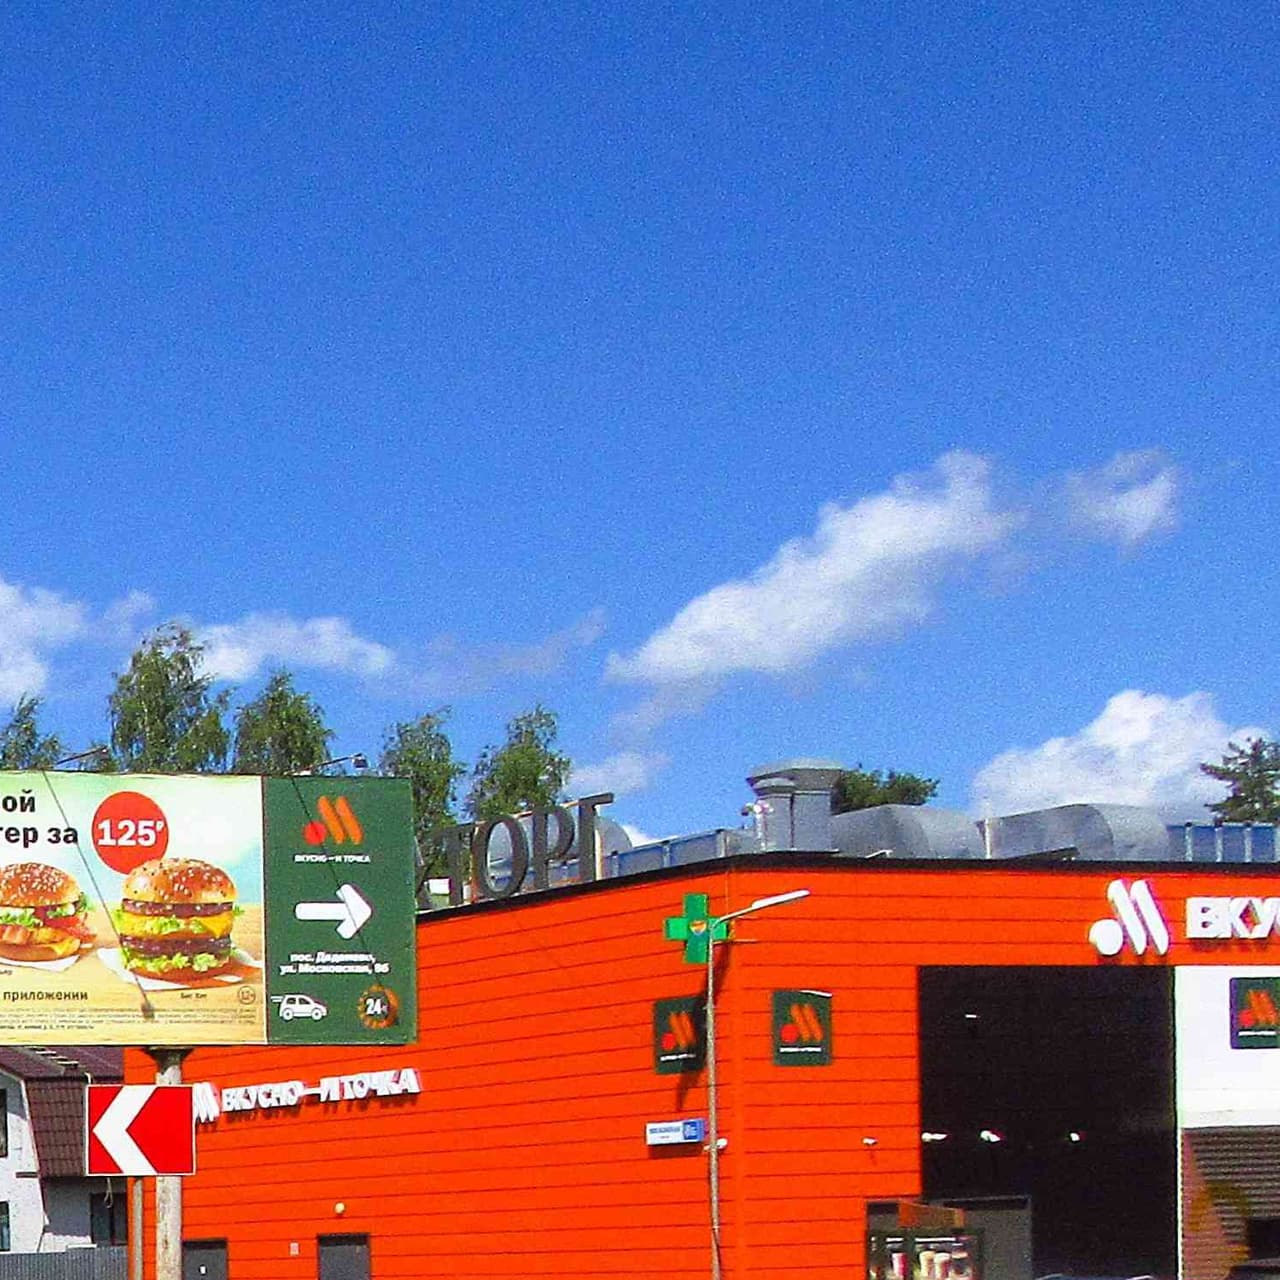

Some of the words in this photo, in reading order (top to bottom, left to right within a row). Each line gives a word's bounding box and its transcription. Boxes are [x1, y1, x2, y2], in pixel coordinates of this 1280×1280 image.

[47, 828, 78, 844] за
[1186, 897, 1280, 938] ВКУ
[3, 990, 89, 1002] приложении
[222, 1080, 306, 1112] ВКУСНО
[341, 1068, 421, 1099] ТОЧКА
